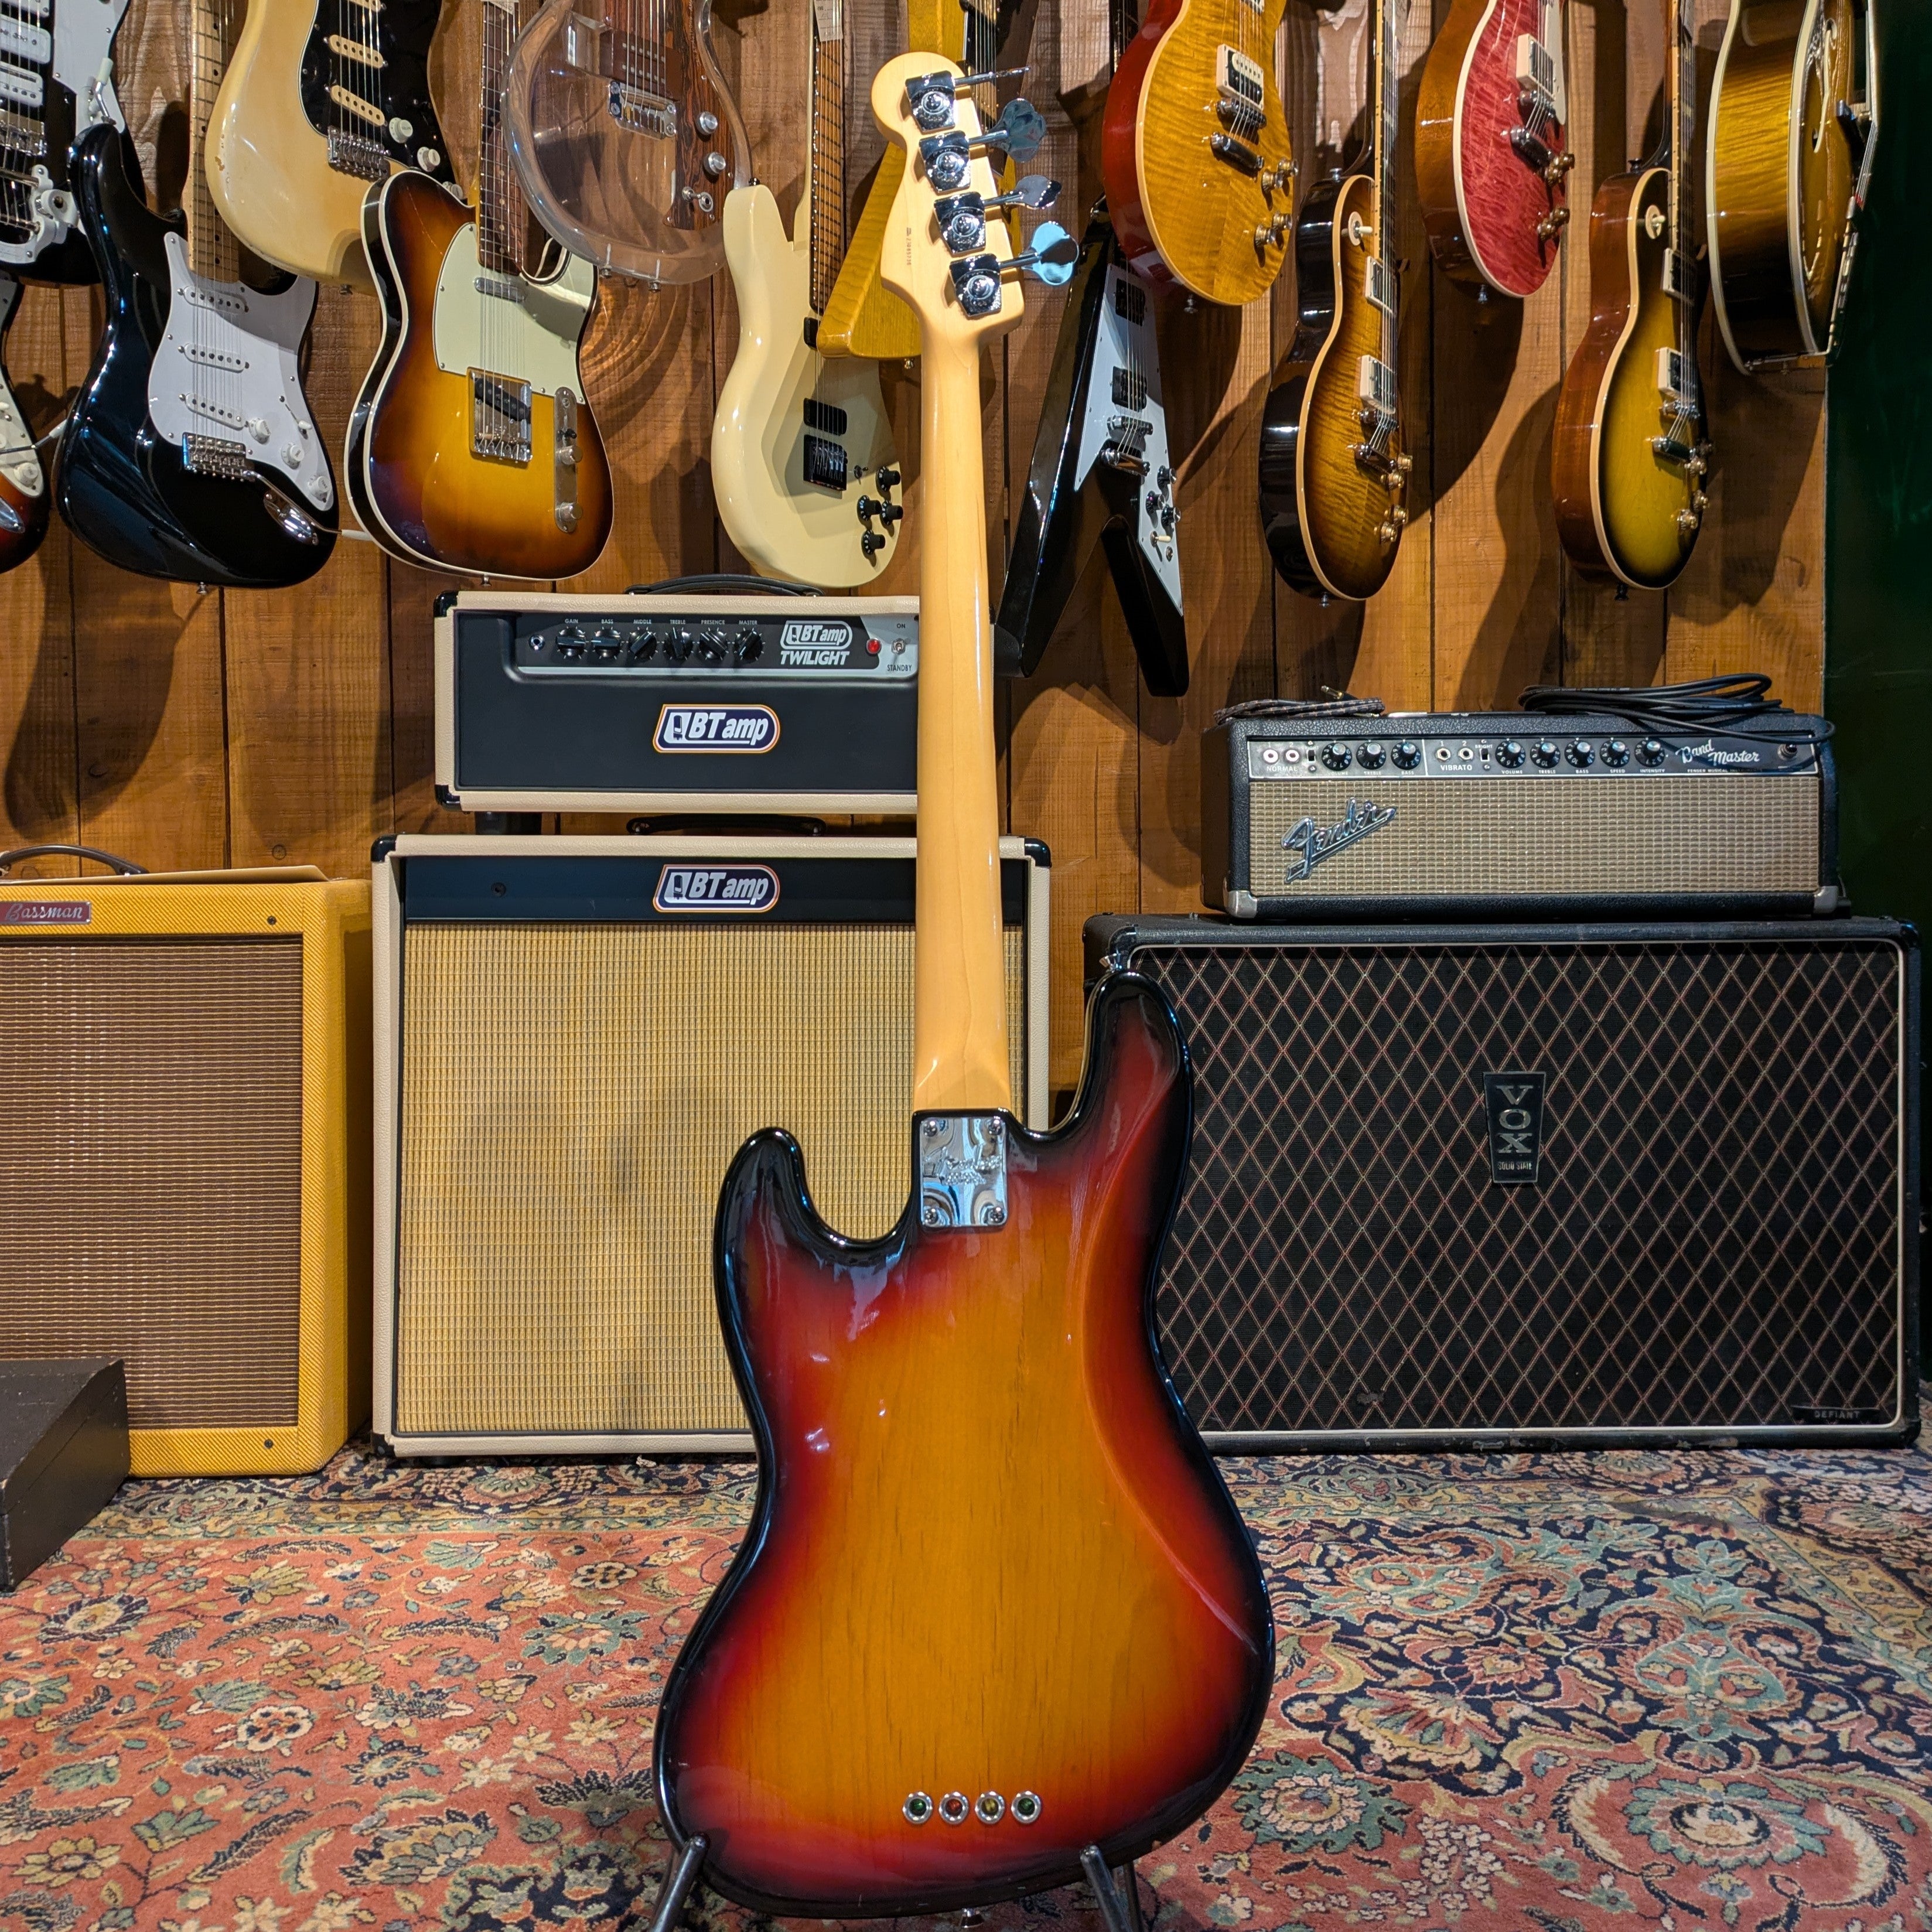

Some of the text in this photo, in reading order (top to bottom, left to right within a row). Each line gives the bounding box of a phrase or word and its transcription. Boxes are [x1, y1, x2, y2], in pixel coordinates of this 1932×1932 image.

[780, 651, 850, 665] TWILIGHT
[1675, 739, 1715, 764] Band
[1708, 750, 1760, 766] Master
[1281, 797, 1398, 884] Fender
[5, 903, 83, 922] Bassman
[1496, 1085, 1533, 1154] VOX
[1497, 1162, 1515, 1170] SOLID
[1814, 1411, 1861, 1419] DEFIANT
